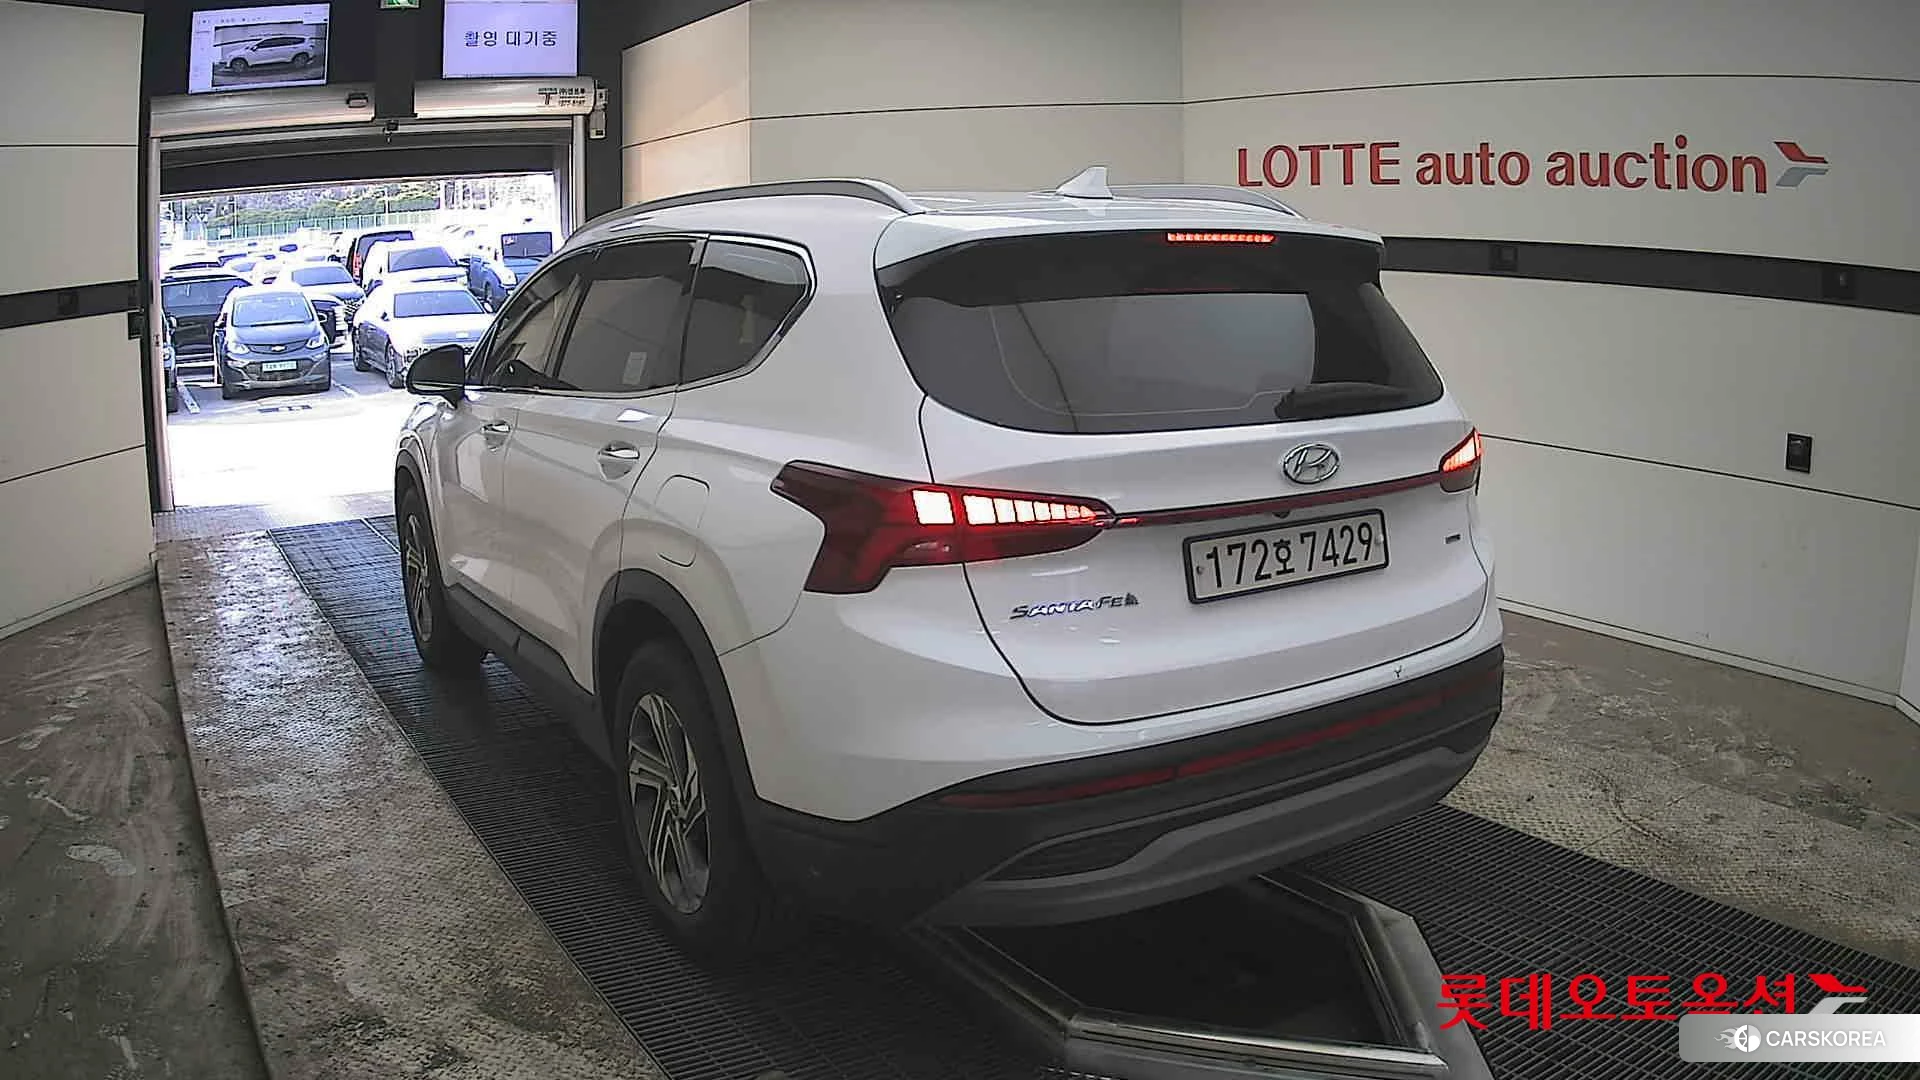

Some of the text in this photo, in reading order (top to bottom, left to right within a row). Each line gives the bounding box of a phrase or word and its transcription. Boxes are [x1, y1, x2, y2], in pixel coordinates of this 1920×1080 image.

[505, 30, 558, 47] 대기중
[1238, 134, 1768, 194] LOTTE auto auction
[1206, 521, 1373, 589] 172호 7429
